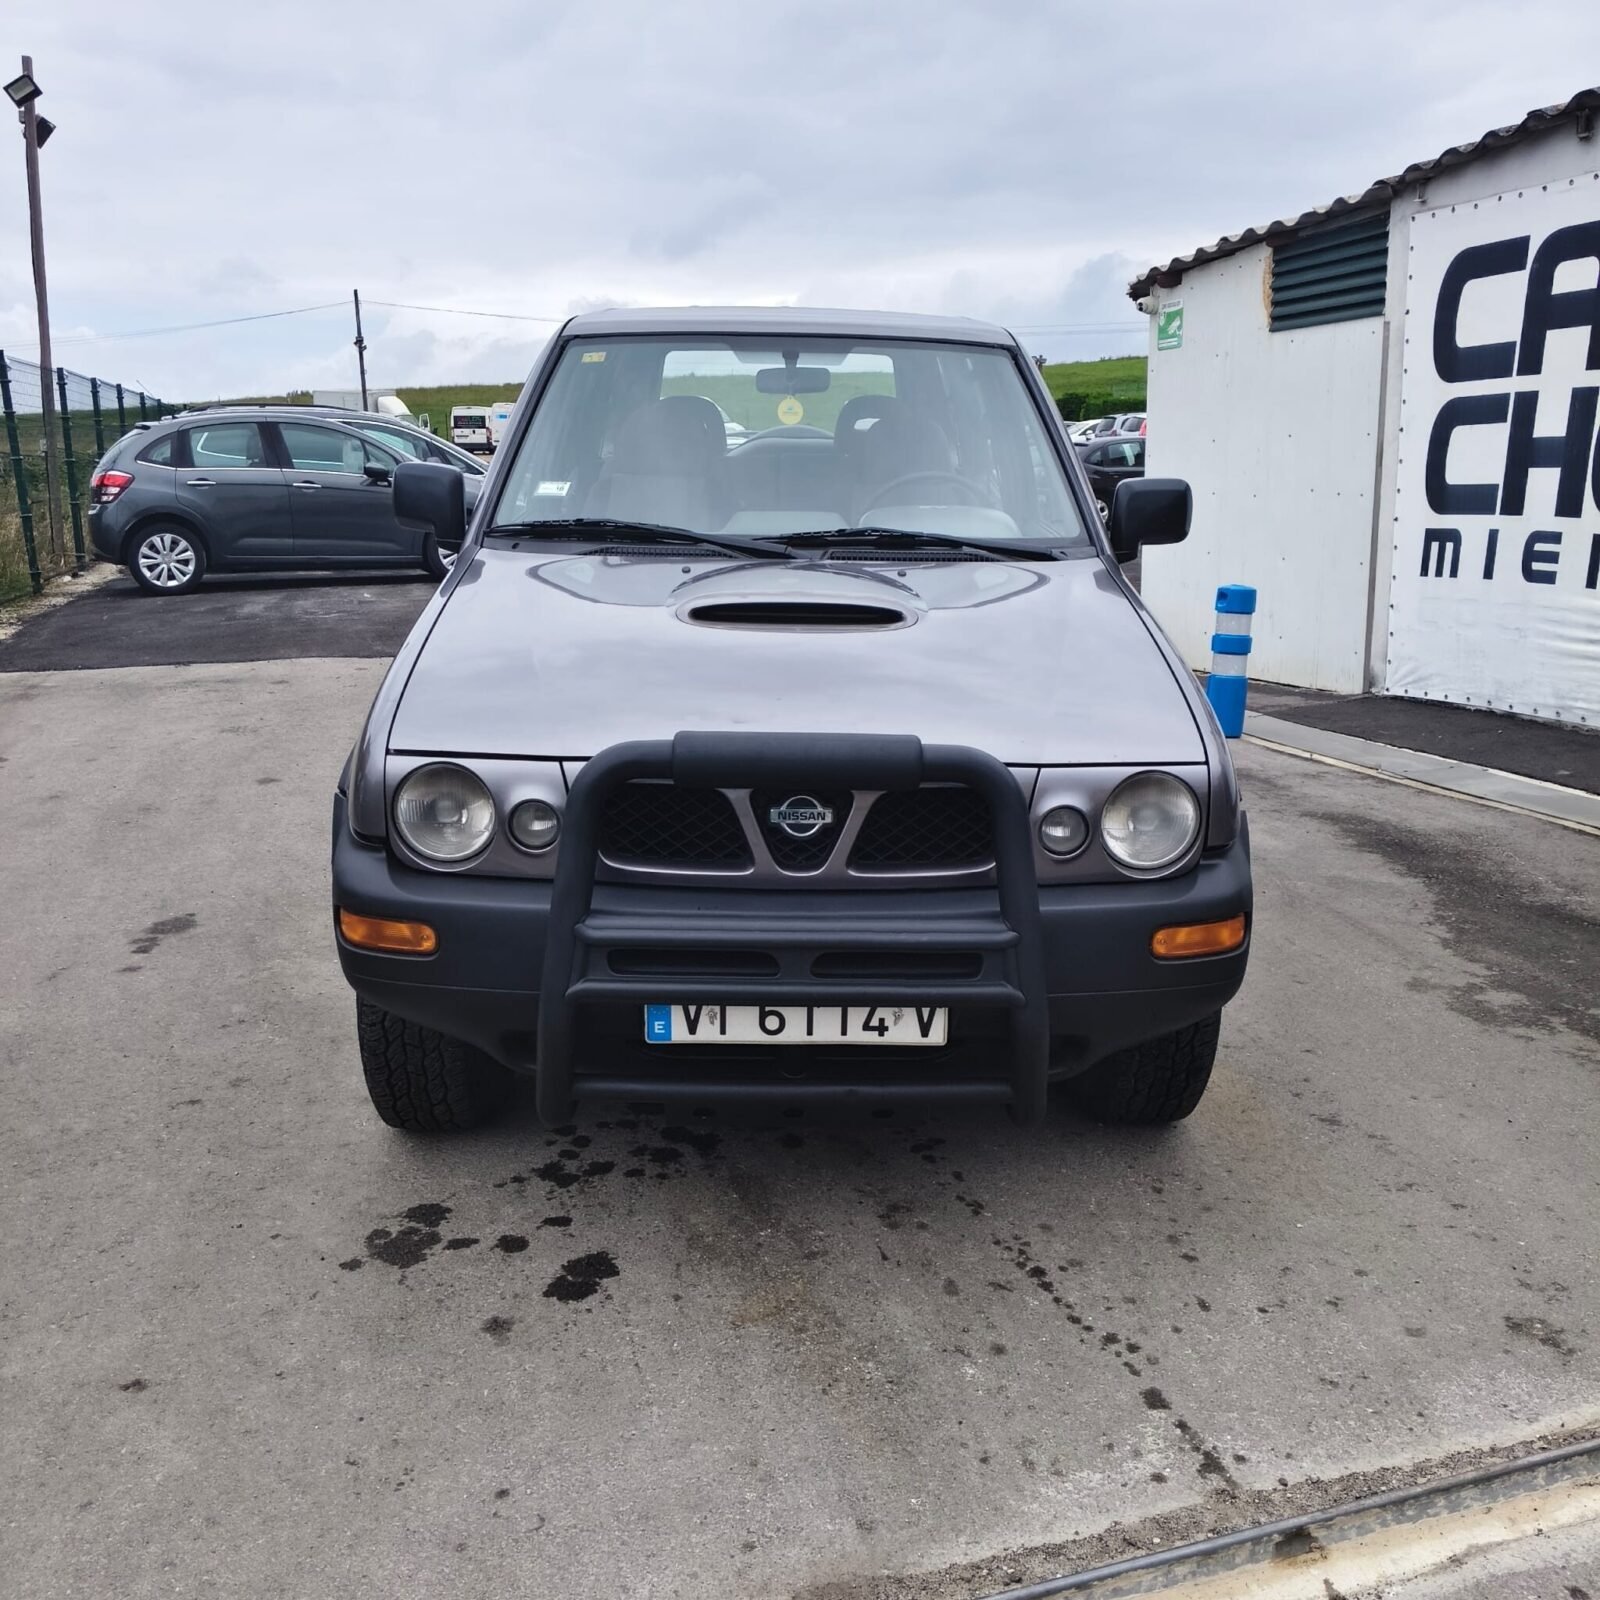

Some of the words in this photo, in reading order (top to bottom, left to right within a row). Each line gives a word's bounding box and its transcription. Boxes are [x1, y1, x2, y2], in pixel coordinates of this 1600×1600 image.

[1425, 386, 1600, 518] CH
[777, 811, 826, 821] NISSAN
[654, 1021, 665, 1033] E
